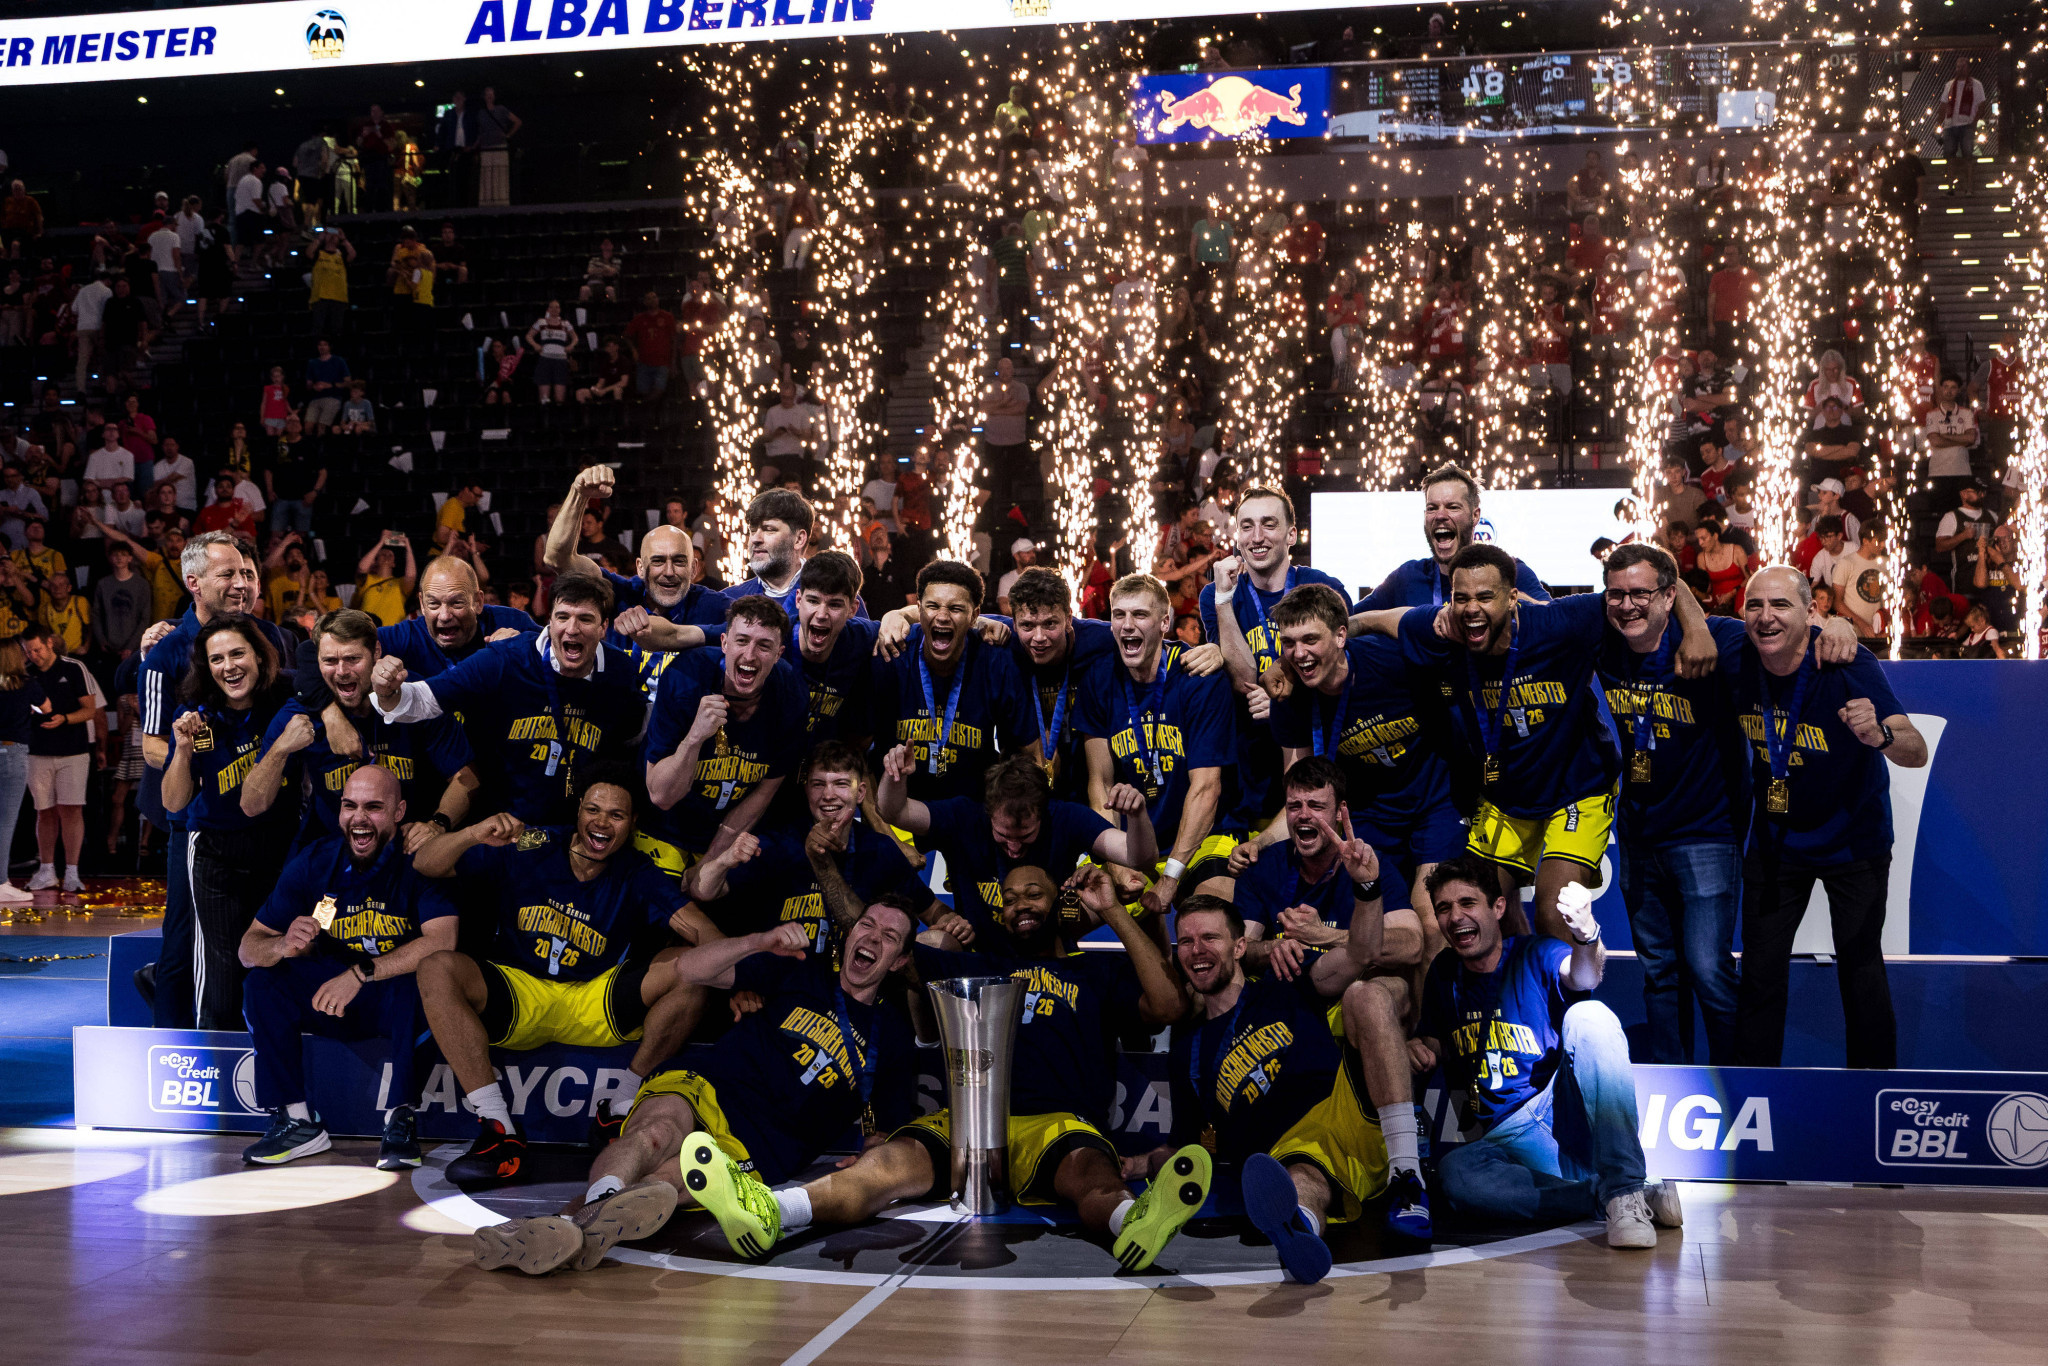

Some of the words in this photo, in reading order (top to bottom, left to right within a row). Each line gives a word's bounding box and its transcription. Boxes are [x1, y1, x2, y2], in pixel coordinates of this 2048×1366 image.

[466, 0, 631, 44] ALBA
[41, 26, 217, 66] MEISTER
[1518, 681, 1567, 706] MEISTER
[1527, 708, 1545, 726] 26
[1371, 716, 1420, 745] MEISTER
[1653, 722, 1671, 739] 26
[529, 743, 549, 761] 20
[1159, 755, 1174, 772] 26
[1387, 742, 1406, 760] 26
[702, 784, 721, 799] 20
[516, 905, 571, 940] DEUTSCHER
[568, 917, 608, 958] MEISTER
[533, 938, 551, 960] 20
[560, 948, 581, 968] 26
[1036, 998, 1055, 1017] 26
[779, 1006, 845, 1057] DEUTSCHER
[1242, 1021, 1295, 1061] MEISTER
[177, 1065, 220, 1079] Credit
[791, 1042, 816, 1067] 20
[817, 1066, 839, 1090] 26
[1501, 1057, 1519, 1077] 26
[160, 1080, 220, 1107] BBL
[1913, 1112, 1970, 1127] Credit
[1890, 1129, 1968, 1159] BBL
